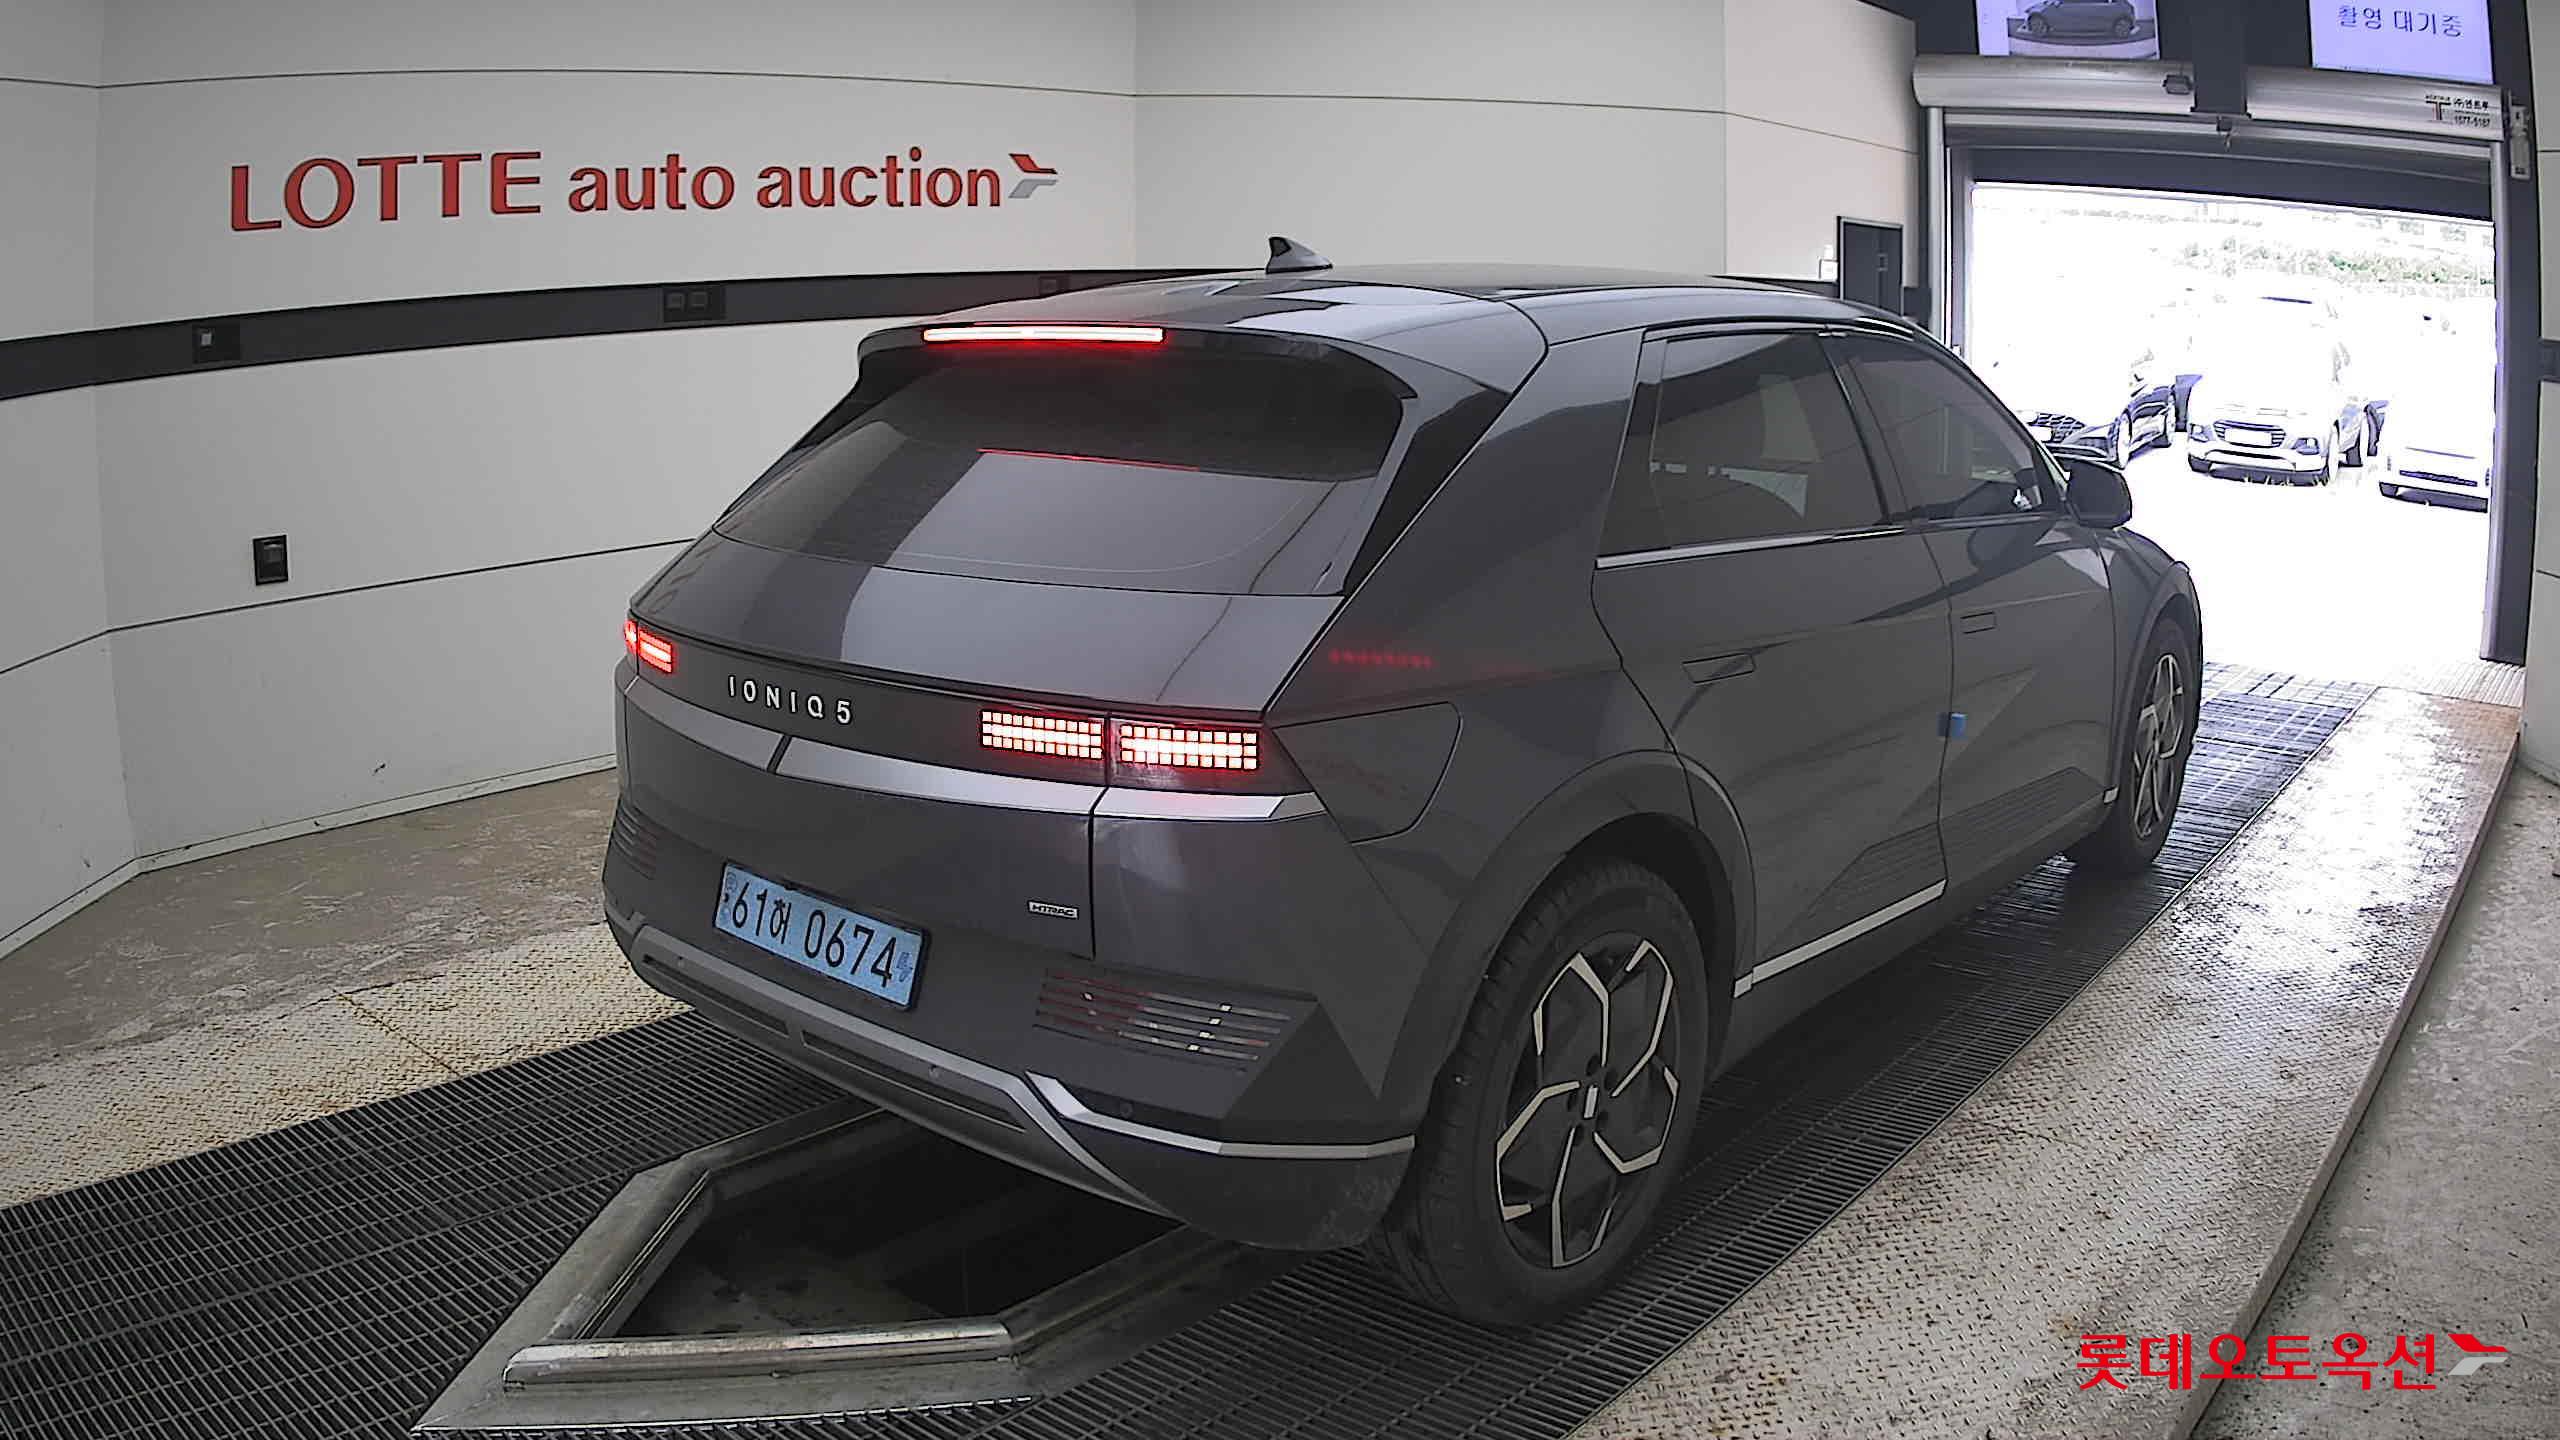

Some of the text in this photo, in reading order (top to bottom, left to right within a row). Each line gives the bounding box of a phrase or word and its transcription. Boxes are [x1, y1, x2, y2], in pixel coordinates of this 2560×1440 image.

[2338, 5, 2463, 38] 촬영 대기중
[231, 145, 1001, 232] LOTTE auto auction
[728, 675, 851, 724] IONIQ 5
[732, 881, 792, 945] 61허
[803, 908, 898, 989] 0674
